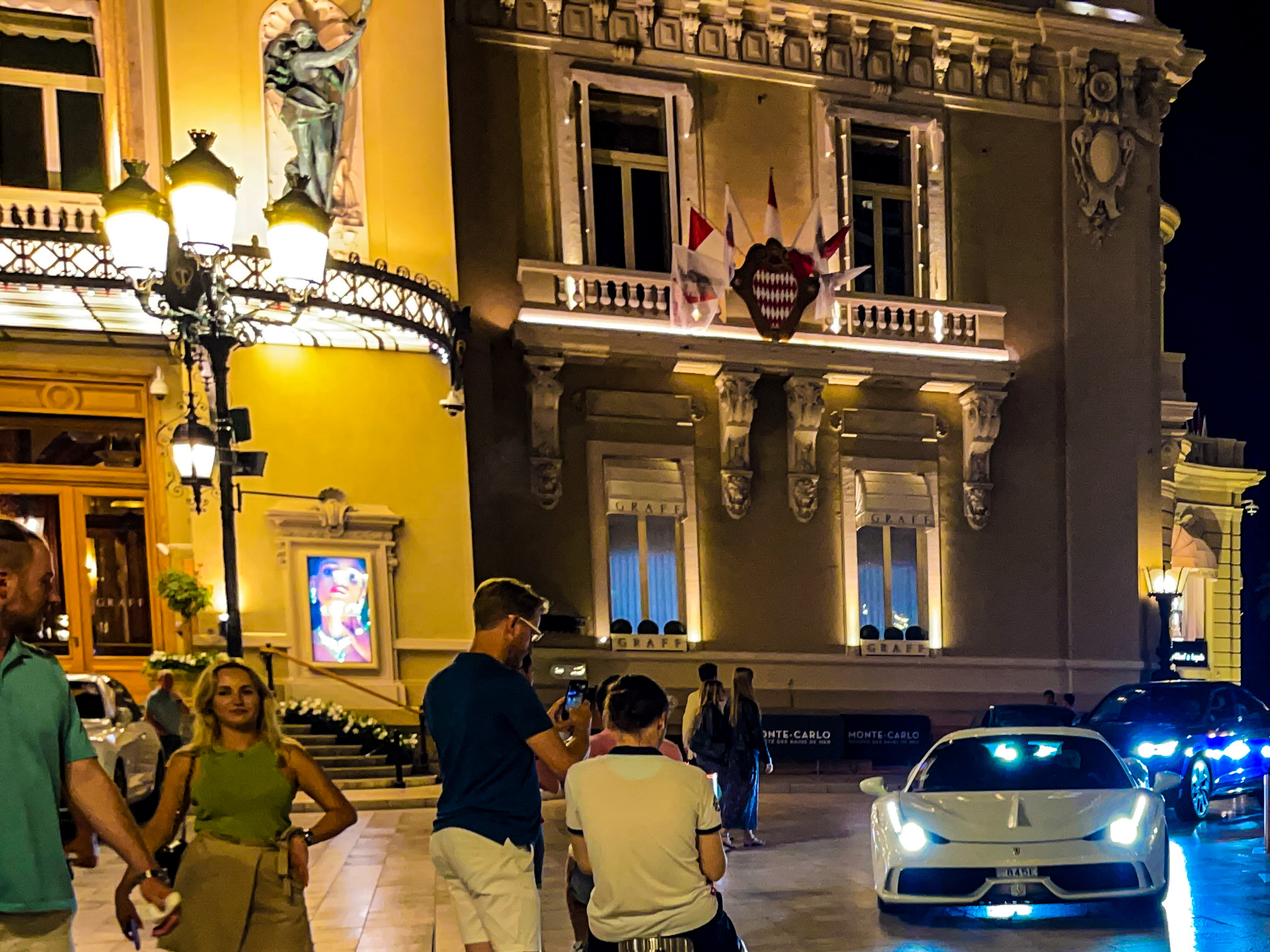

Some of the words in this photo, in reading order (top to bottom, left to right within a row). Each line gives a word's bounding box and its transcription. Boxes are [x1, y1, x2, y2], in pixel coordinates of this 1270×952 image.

[615, 501, 681, 514] GRAFF
[871, 513, 931, 525] GRAFF
[617, 637, 683, 649] GRAFF
[866, 642, 925, 654] GRAFF
